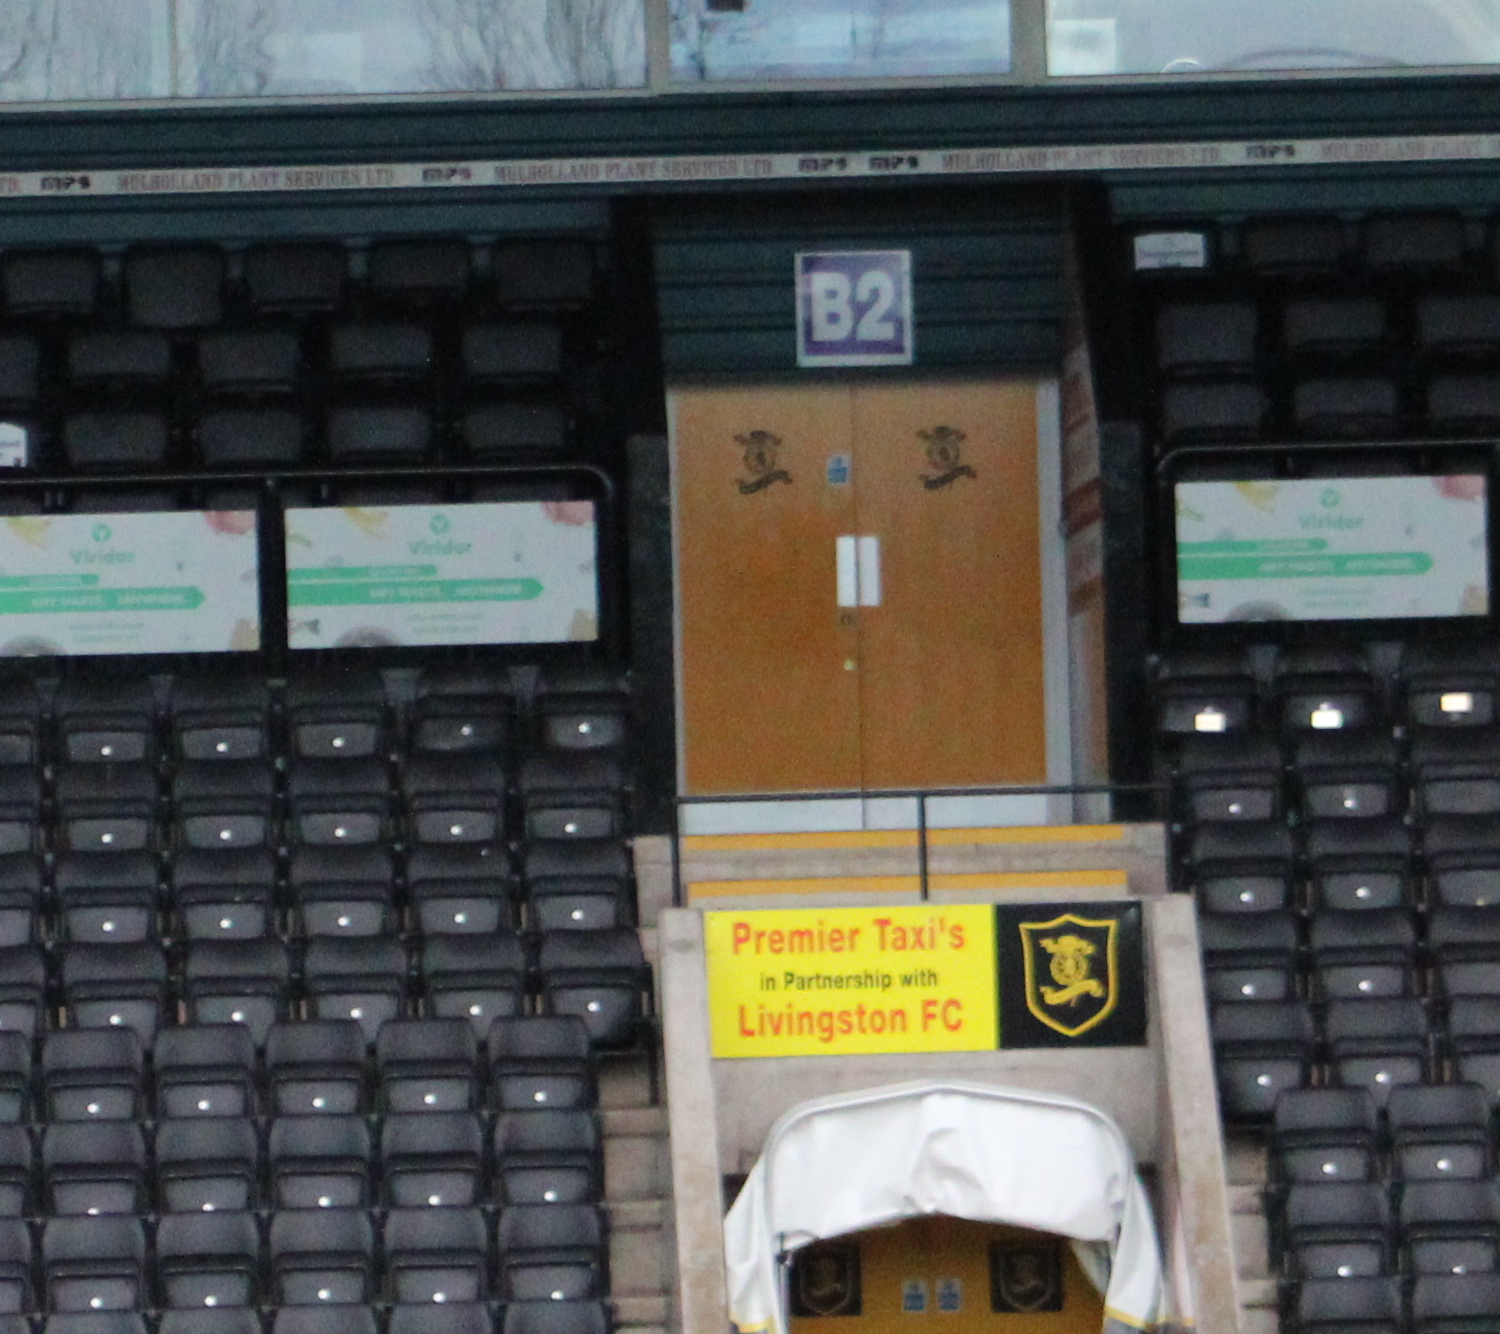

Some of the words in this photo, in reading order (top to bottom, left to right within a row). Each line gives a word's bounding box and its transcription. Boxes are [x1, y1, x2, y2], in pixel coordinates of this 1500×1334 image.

[810, 271, 902, 344] B2
[733, 921, 861, 954] Premier
[873, 917, 965, 951] Taxi's
[760, 973, 776, 990] in
[784, 971, 891, 992] Partnership
[900, 969, 938, 987] with
[738, 1003, 907, 1043] Livingston
[921, 999, 962, 1032] FC
